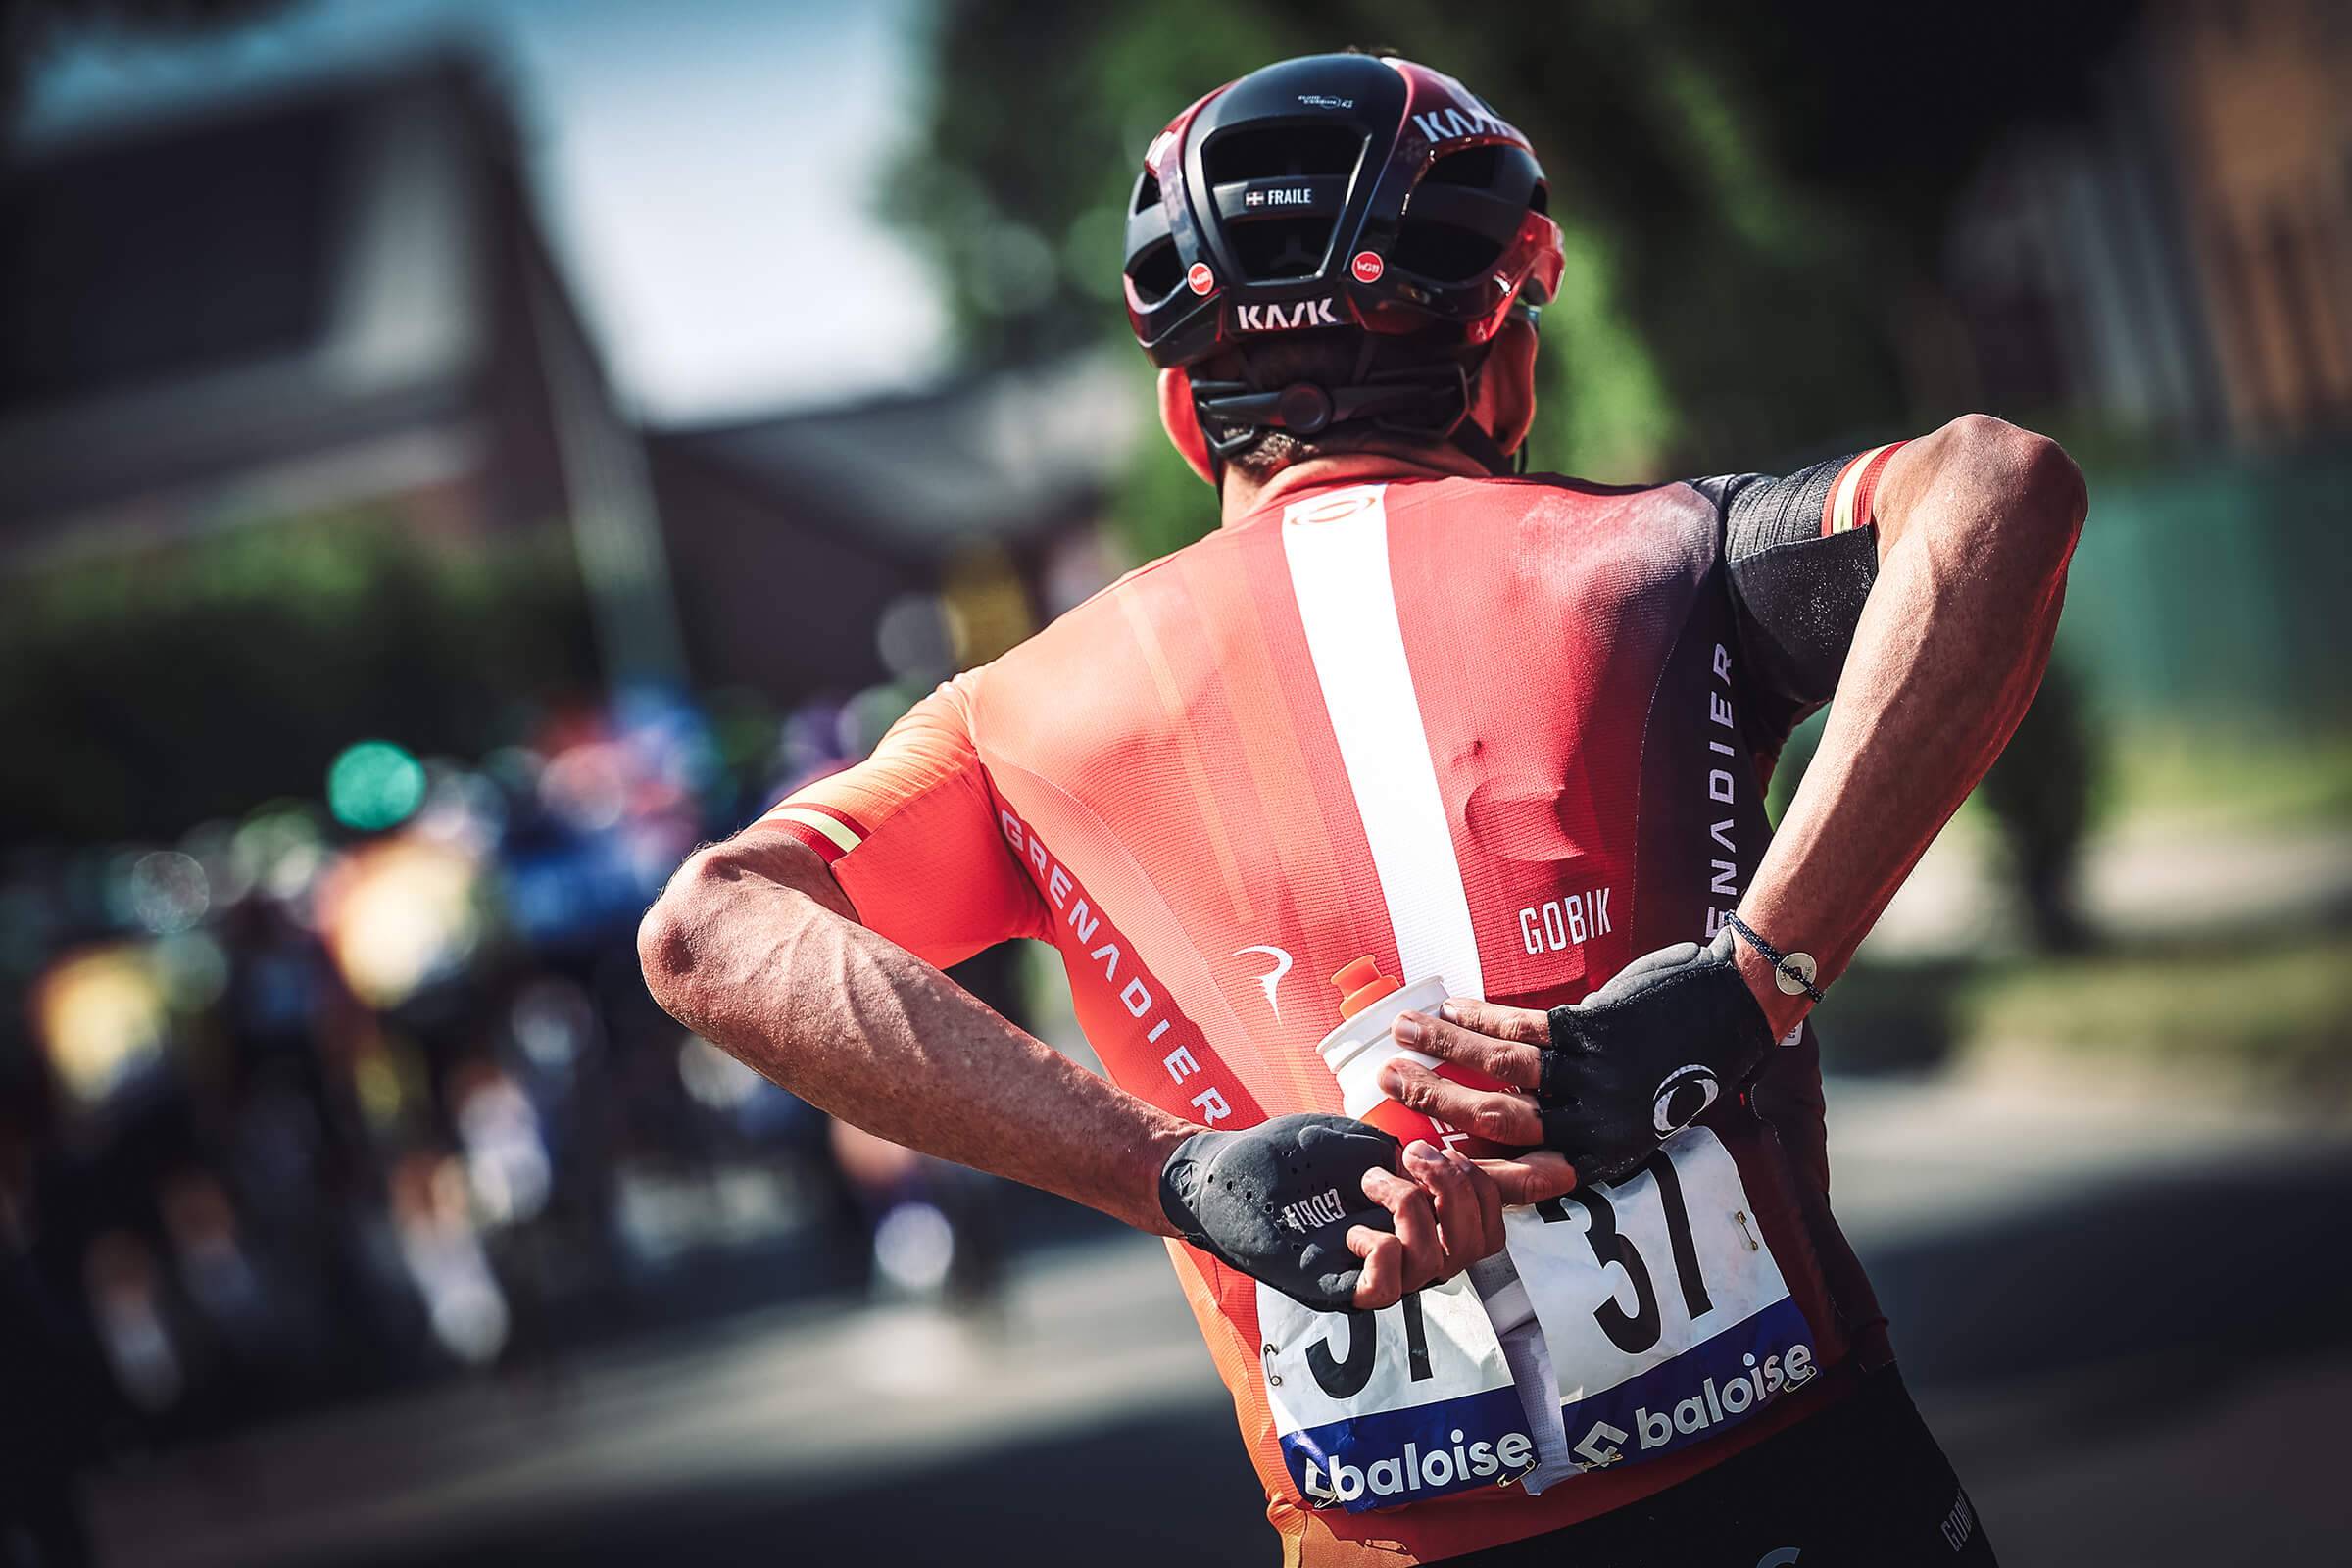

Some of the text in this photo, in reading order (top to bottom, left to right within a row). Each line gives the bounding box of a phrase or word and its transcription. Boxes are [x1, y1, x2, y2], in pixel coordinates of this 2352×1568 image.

[1268, 188, 1311, 205] FRAILE
[1237, 298, 1337, 330] KASK
[1705, 642, 1739, 939] ENADIER
[1519, 887, 1612, 955] GOBIK
[1002, 809, 1232, 1126] GRENADIER
[1535, 1148, 1714, 1355] 37
[1635, 1344, 1812, 1450] baloise
[1329, 1428, 1534, 1502] baloise
